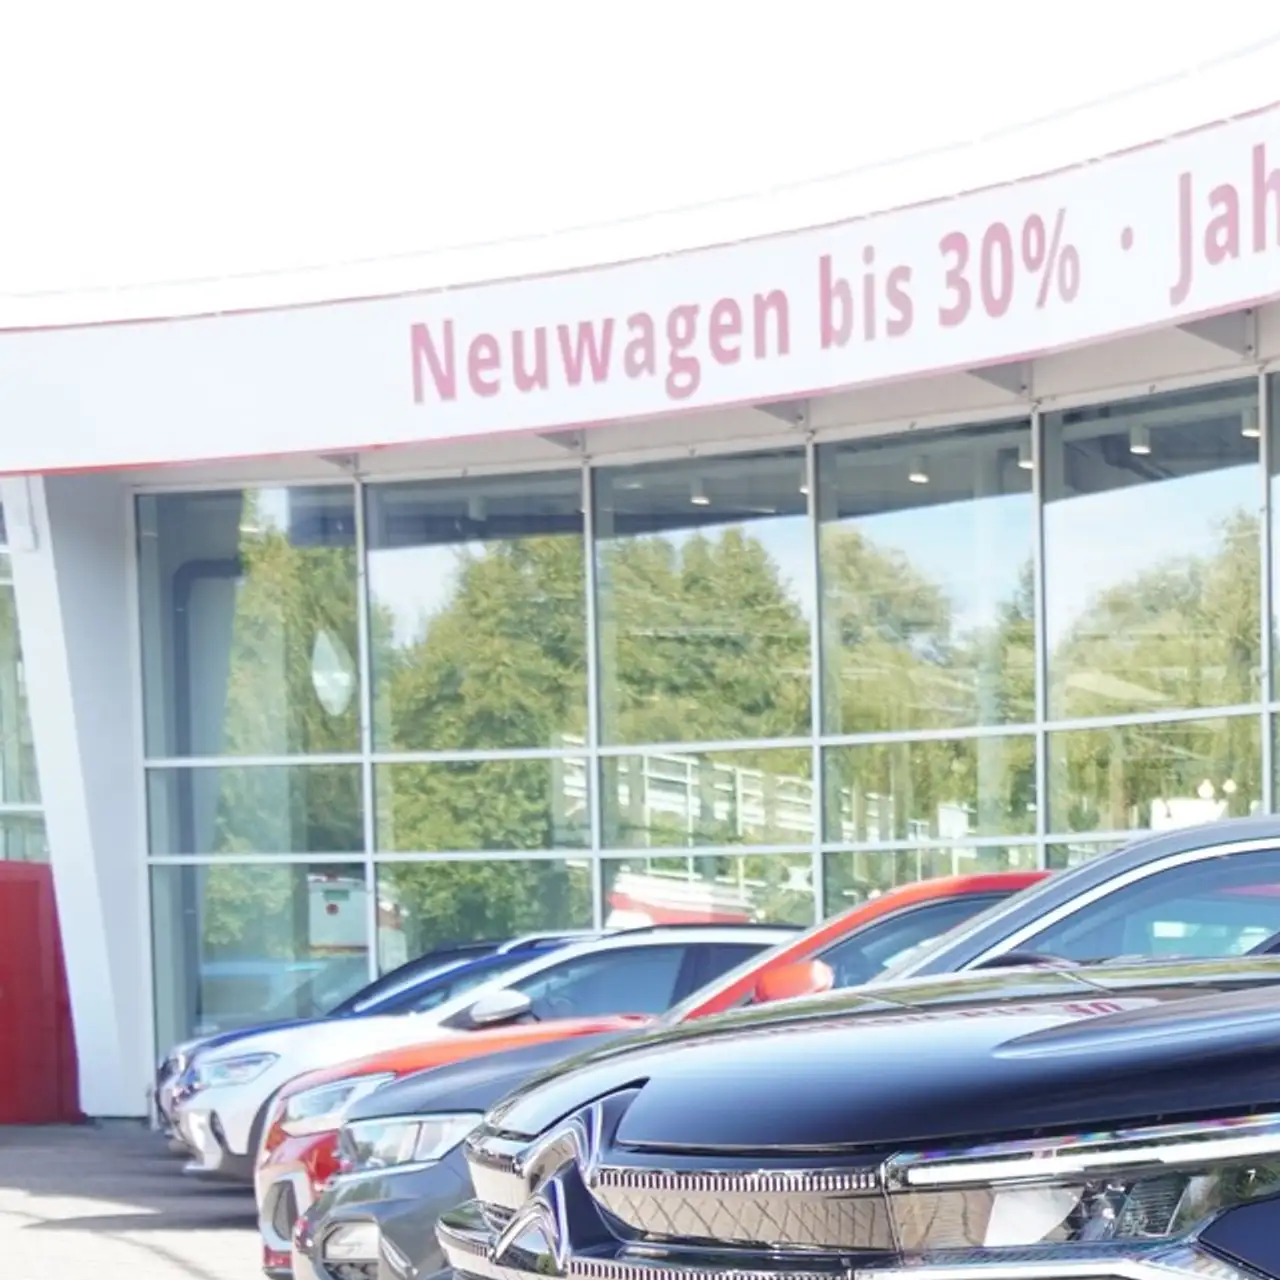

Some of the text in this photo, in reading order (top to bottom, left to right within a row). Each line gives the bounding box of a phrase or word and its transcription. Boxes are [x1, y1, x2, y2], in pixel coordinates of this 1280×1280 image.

[410, 288, 791, 405] Neuwagen
[818, 245, 914, 350] bis
[938, 207, 1081, 328] 30%
